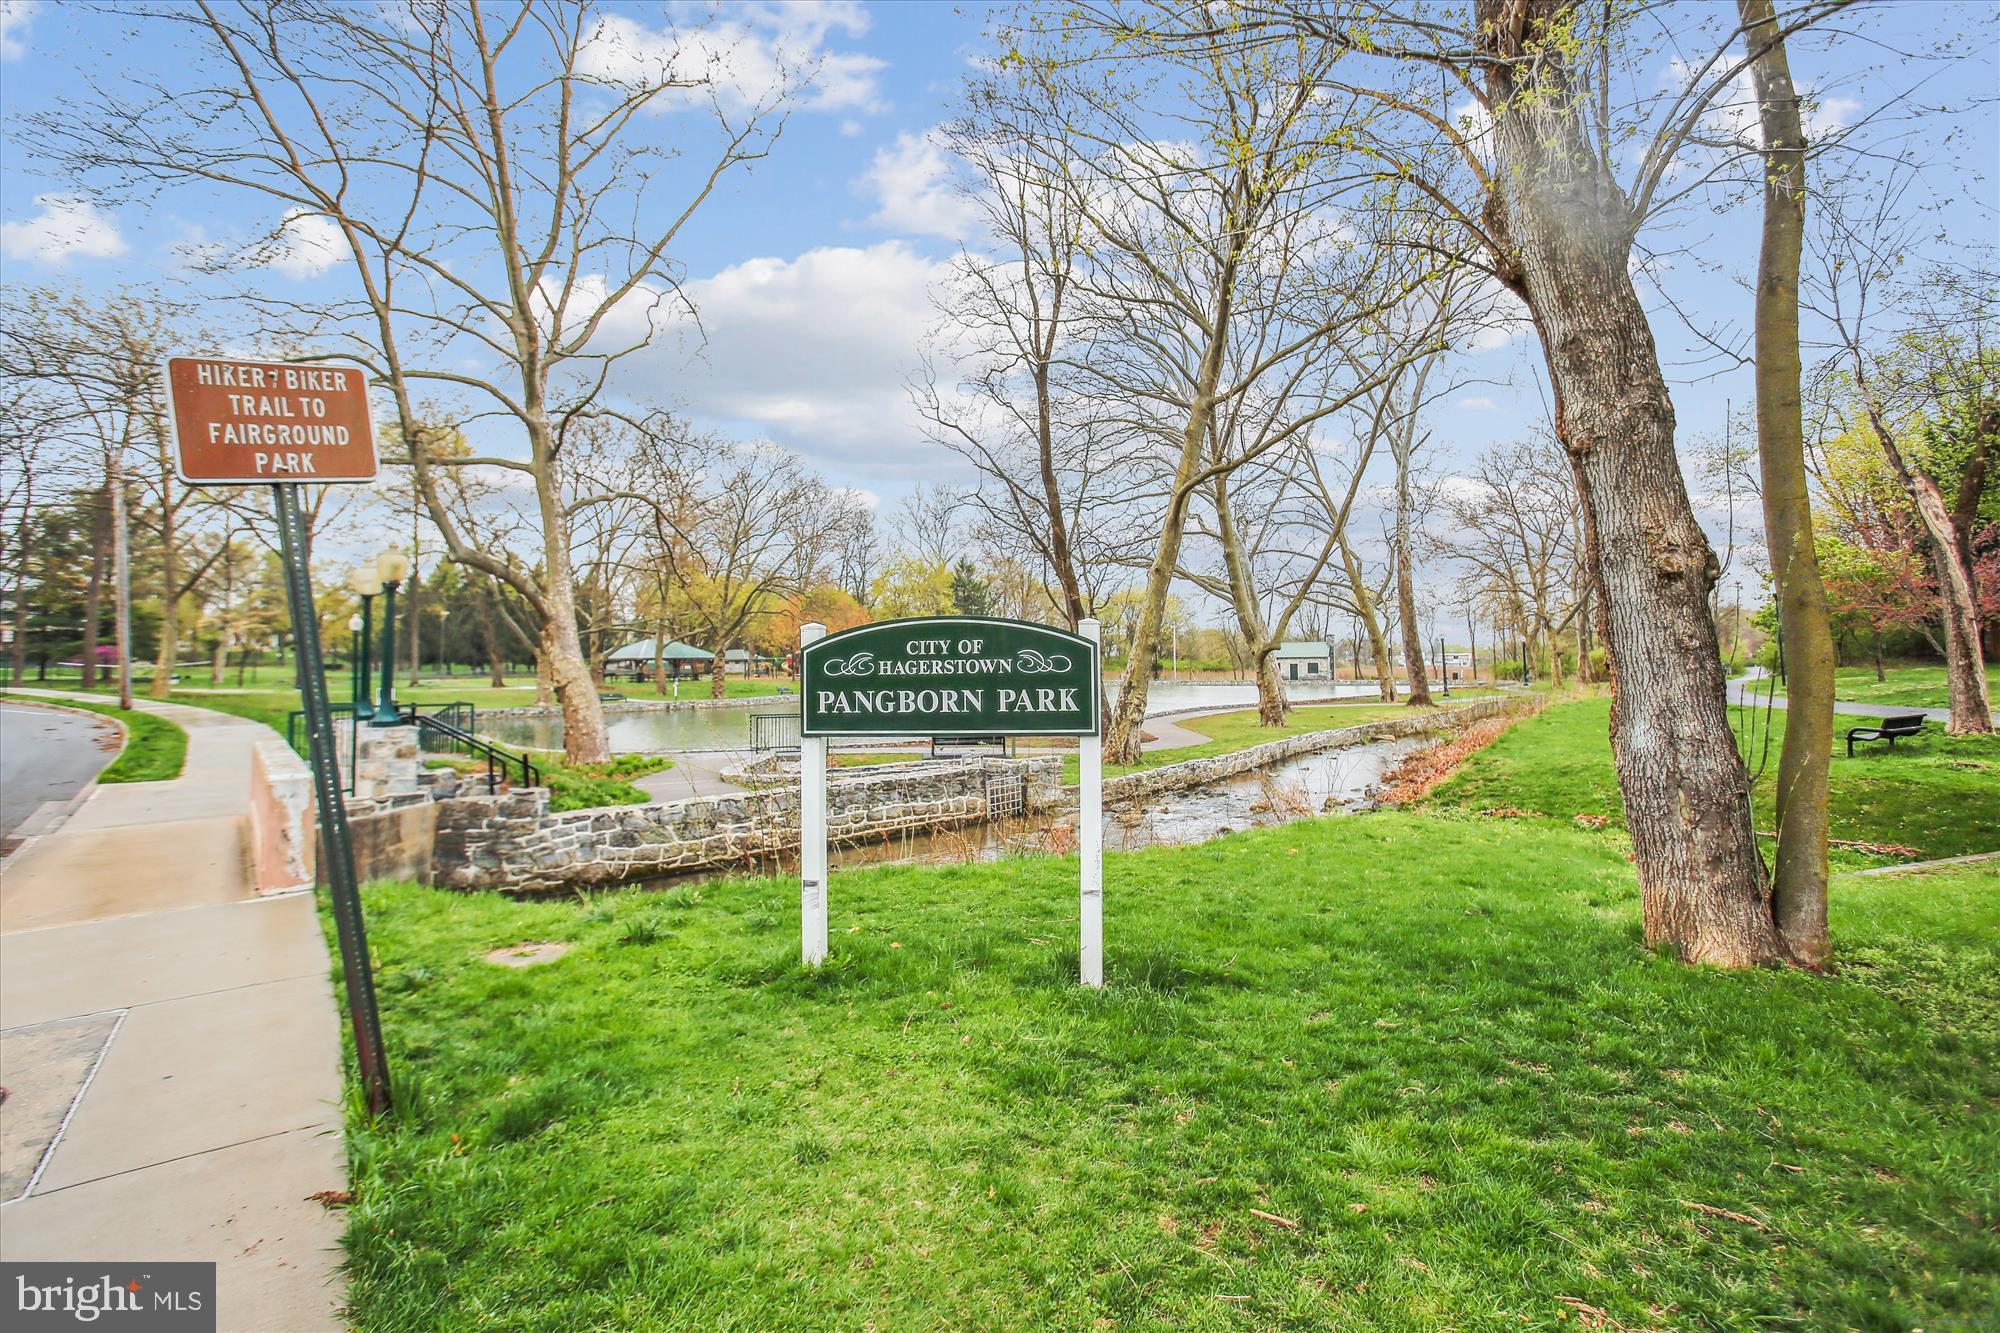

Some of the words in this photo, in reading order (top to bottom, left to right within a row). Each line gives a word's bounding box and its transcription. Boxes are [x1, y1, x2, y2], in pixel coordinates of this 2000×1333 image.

[196, 363, 266, 388] HIKER
[285, 369, 348, 392] BIKER
[228, 394, 295, 417] TRAIL
[298, 396, 326, 418] TO
[208, 422, 350, 446] FAIRGROUND
[255, 452, 316, 474] PARK
[906, 639, 951, 655] CITY
[958, 639, 984, 655] OF
[878, 658, 1012, 676] HAGERSTOWN
[816, 689, 985, 714] PANGBORN
[997, 688, 1080, 712] PARK
